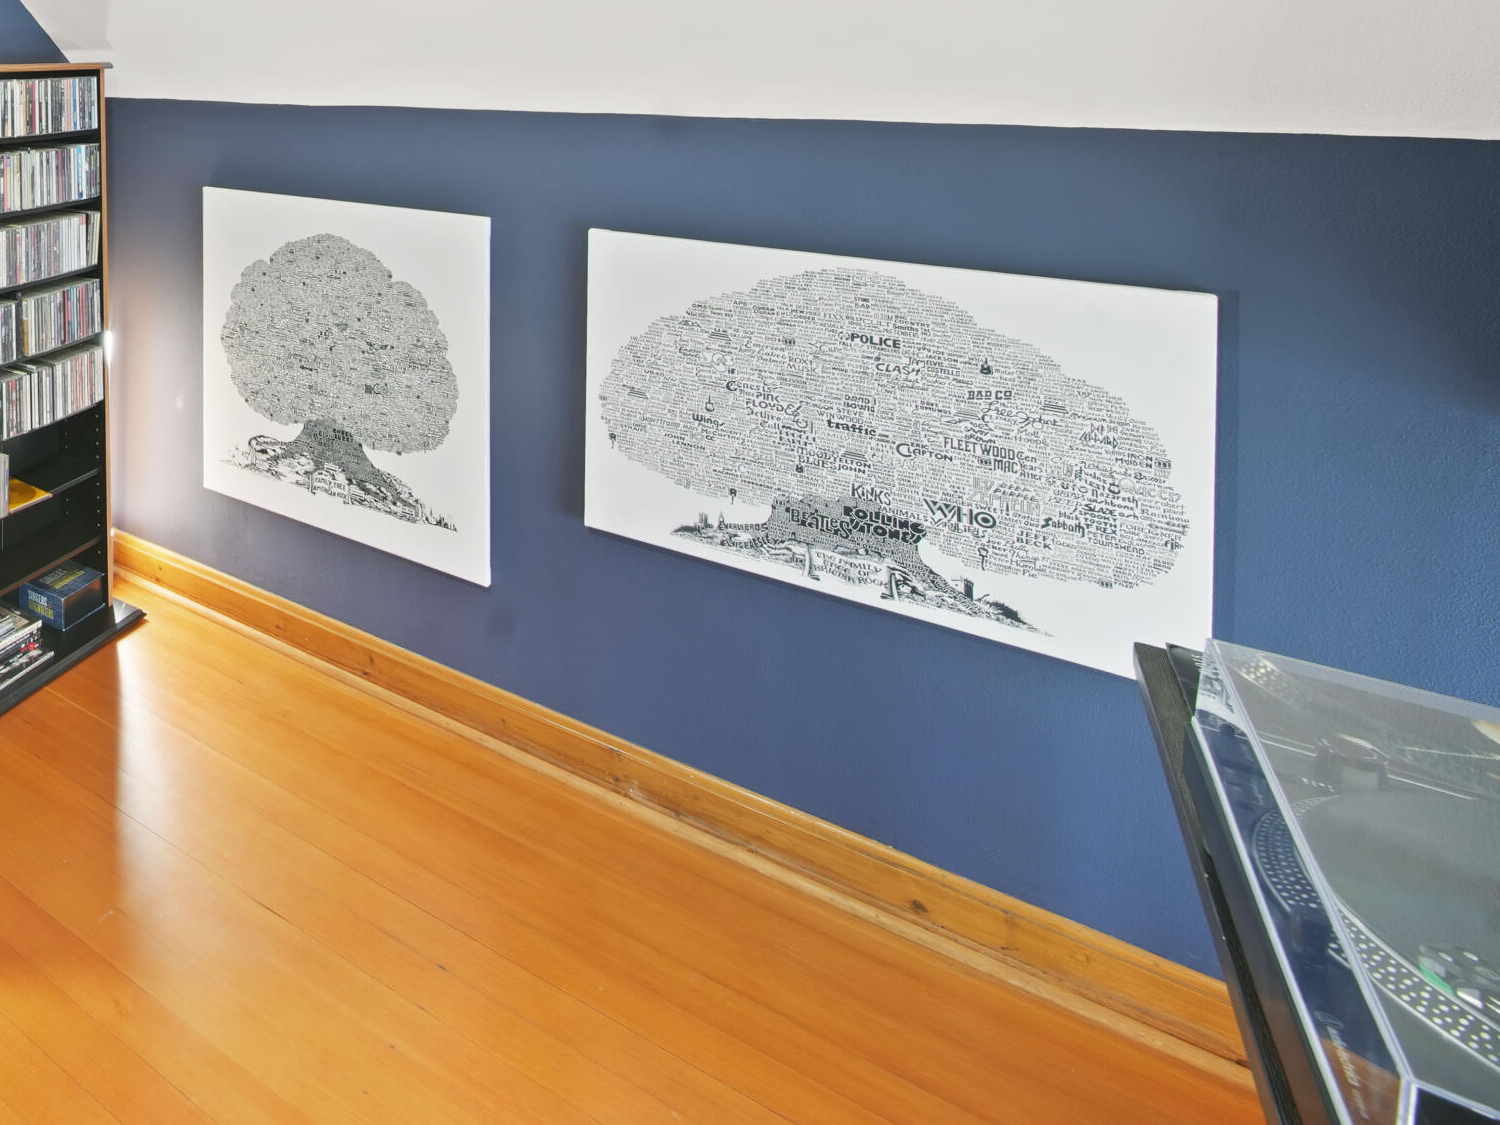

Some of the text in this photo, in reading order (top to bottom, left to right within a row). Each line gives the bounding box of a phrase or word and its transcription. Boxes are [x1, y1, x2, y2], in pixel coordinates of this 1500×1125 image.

[850, 333, 901, 349] POLICE
[927, 367, 960, 376] COSTELLO
[967, 390, 1012, 400] BAD CO
[843, 401, 875, 413] BOWIE
[827, 418, 877, 437] traffic
[664, 433, 685, 441] JOHN
[672, 439, 705, 451] LENNON
[910, 442, 929, 450] ERIC
[943, 436, 1016, 461] FLEETWOOD
[895, 443, 953, 462] CLAPTON
[1127, 453, 1153, 462] IRON
[837, 463, 866, 476] JOHN
[839, 458, 871, 469] ELTON
[993, 458, 1019, 474] MAC
[940, 497, 973, 510] JAGGER
[1082, 503, 1117, 517] SLADE
[843, 505, 927, 534] ROLLING
[880, 506, 931, 523] ANIMALS
[923, 498, 997, 529] WHO
[850, 518, 928, 545] STONES
[1020, 530, 1052, 543] JEFF
[1016, 536, 1052, 550] BECK
